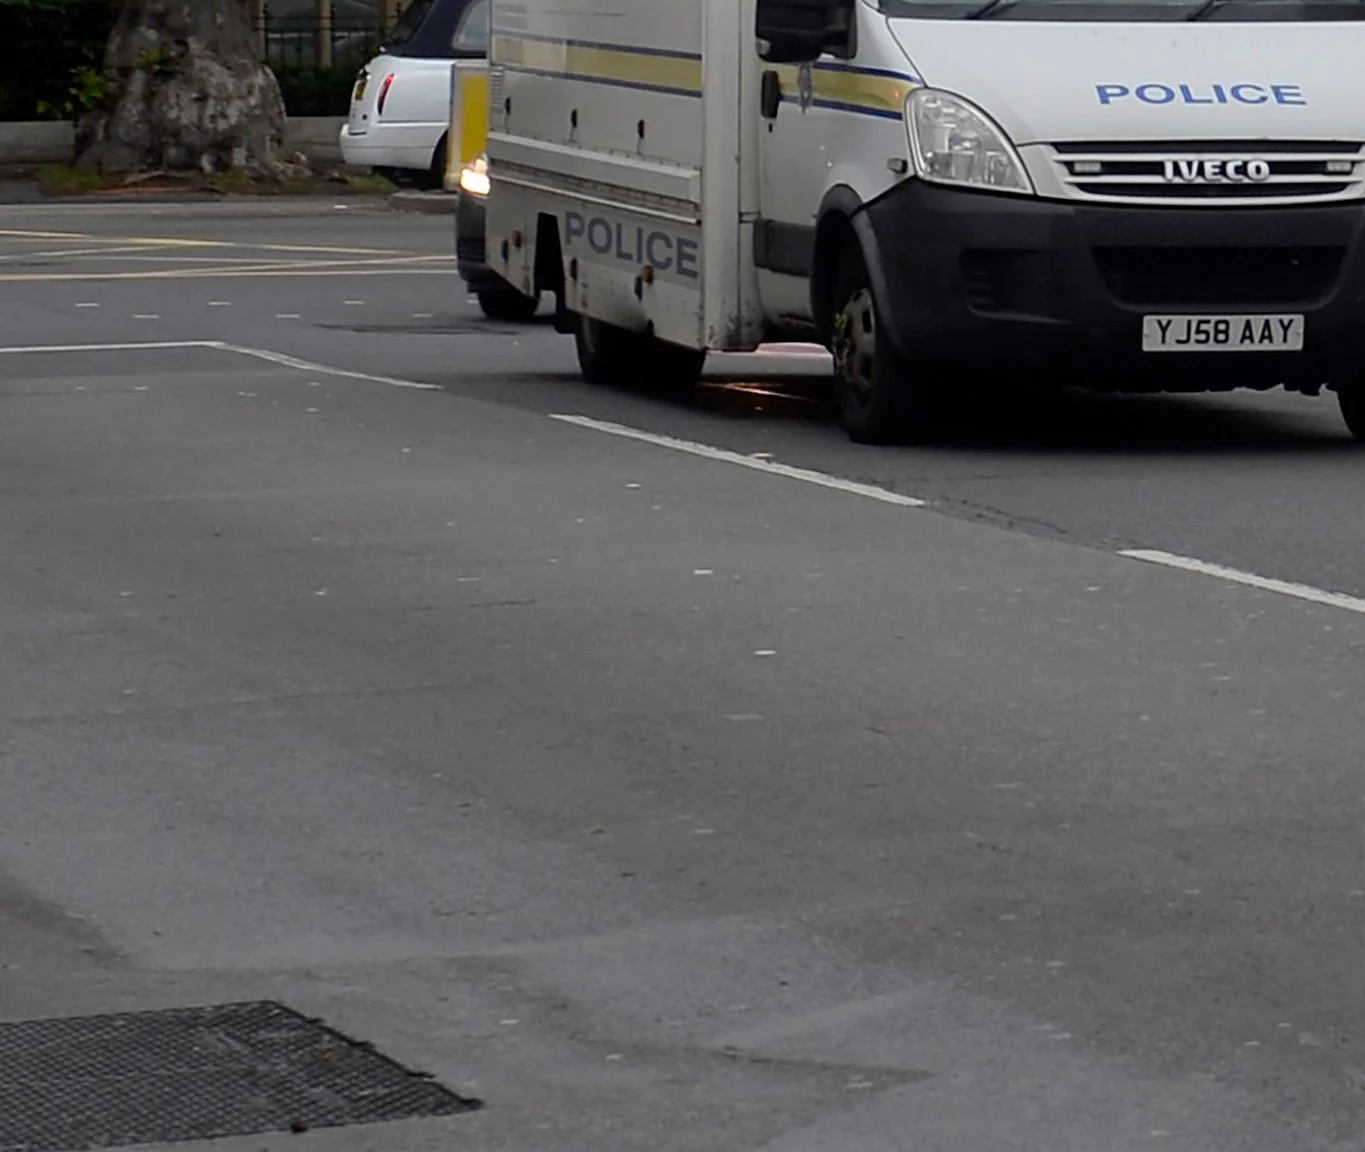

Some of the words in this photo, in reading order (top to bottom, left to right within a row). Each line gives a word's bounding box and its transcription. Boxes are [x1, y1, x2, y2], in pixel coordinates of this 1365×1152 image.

[1095, 83, 1308, 106] POLICE
[1163, 159, 1272, 182] IVECO
[564, 210, 699, 279] POLICE
[1156, 319, 1230, 345] YJ58
[1239, 318, 1295, 345] AAY
